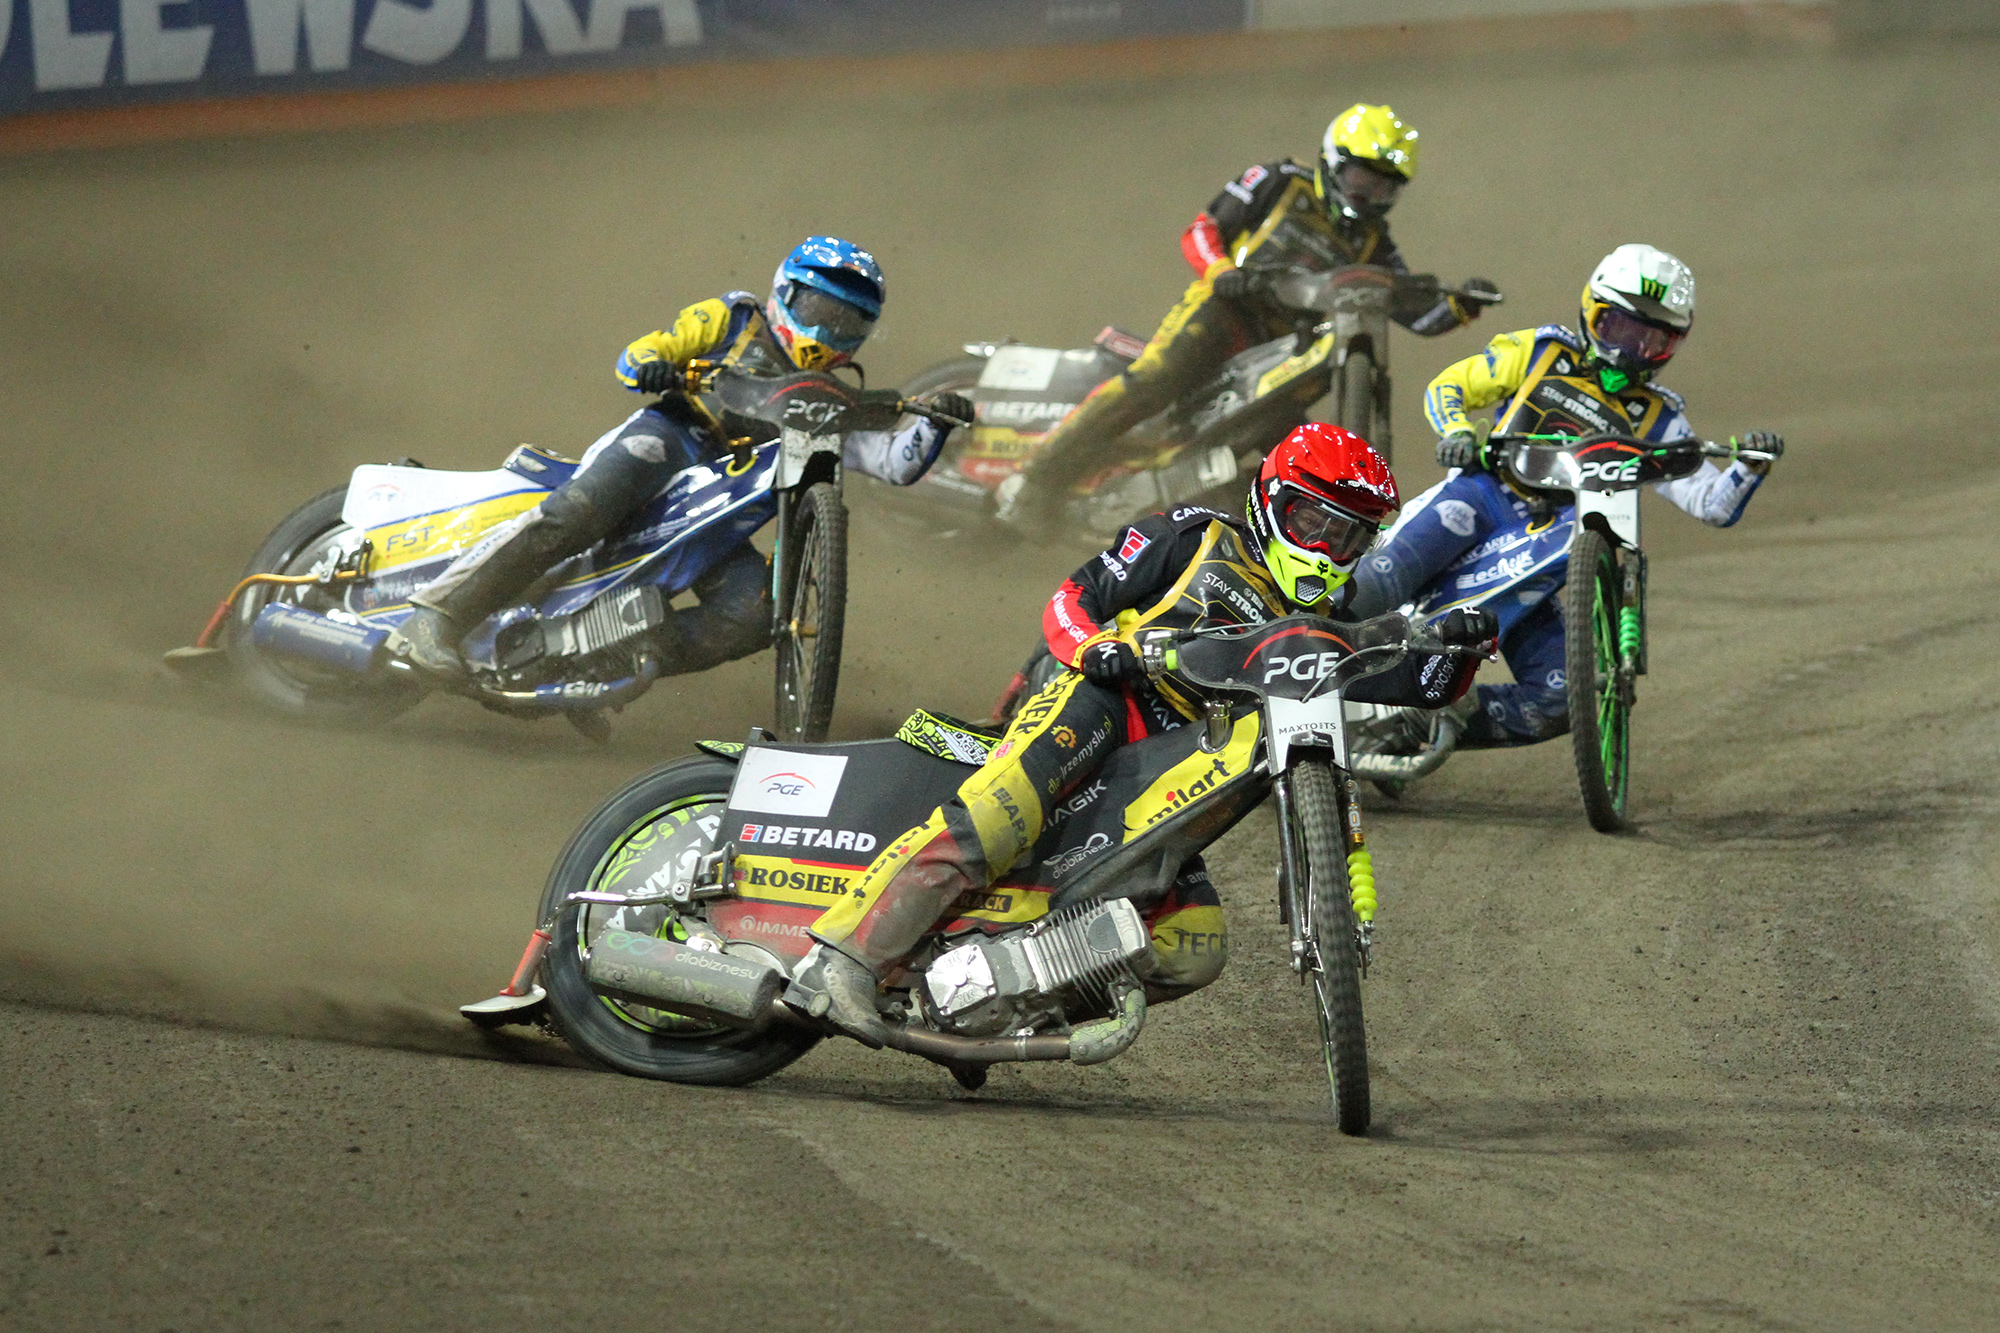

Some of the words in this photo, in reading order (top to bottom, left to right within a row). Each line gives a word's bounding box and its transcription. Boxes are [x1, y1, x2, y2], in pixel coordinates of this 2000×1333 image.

[1580, 461, 1641, 483] PGE
[1202, 572, 1231, 594] STAY
[1263, 652, 1340, 684] PGE
[766, 782, 804, 796] PGE
[1147, 758, 1230, 825] milart
[761, 825, 877, 852] BETARD
[1053, 841, 1113, 879] dlabiznesu
[749, 867, 850, 896] ROSIEK
[674, 952, 760, 980] dlabiznesu
